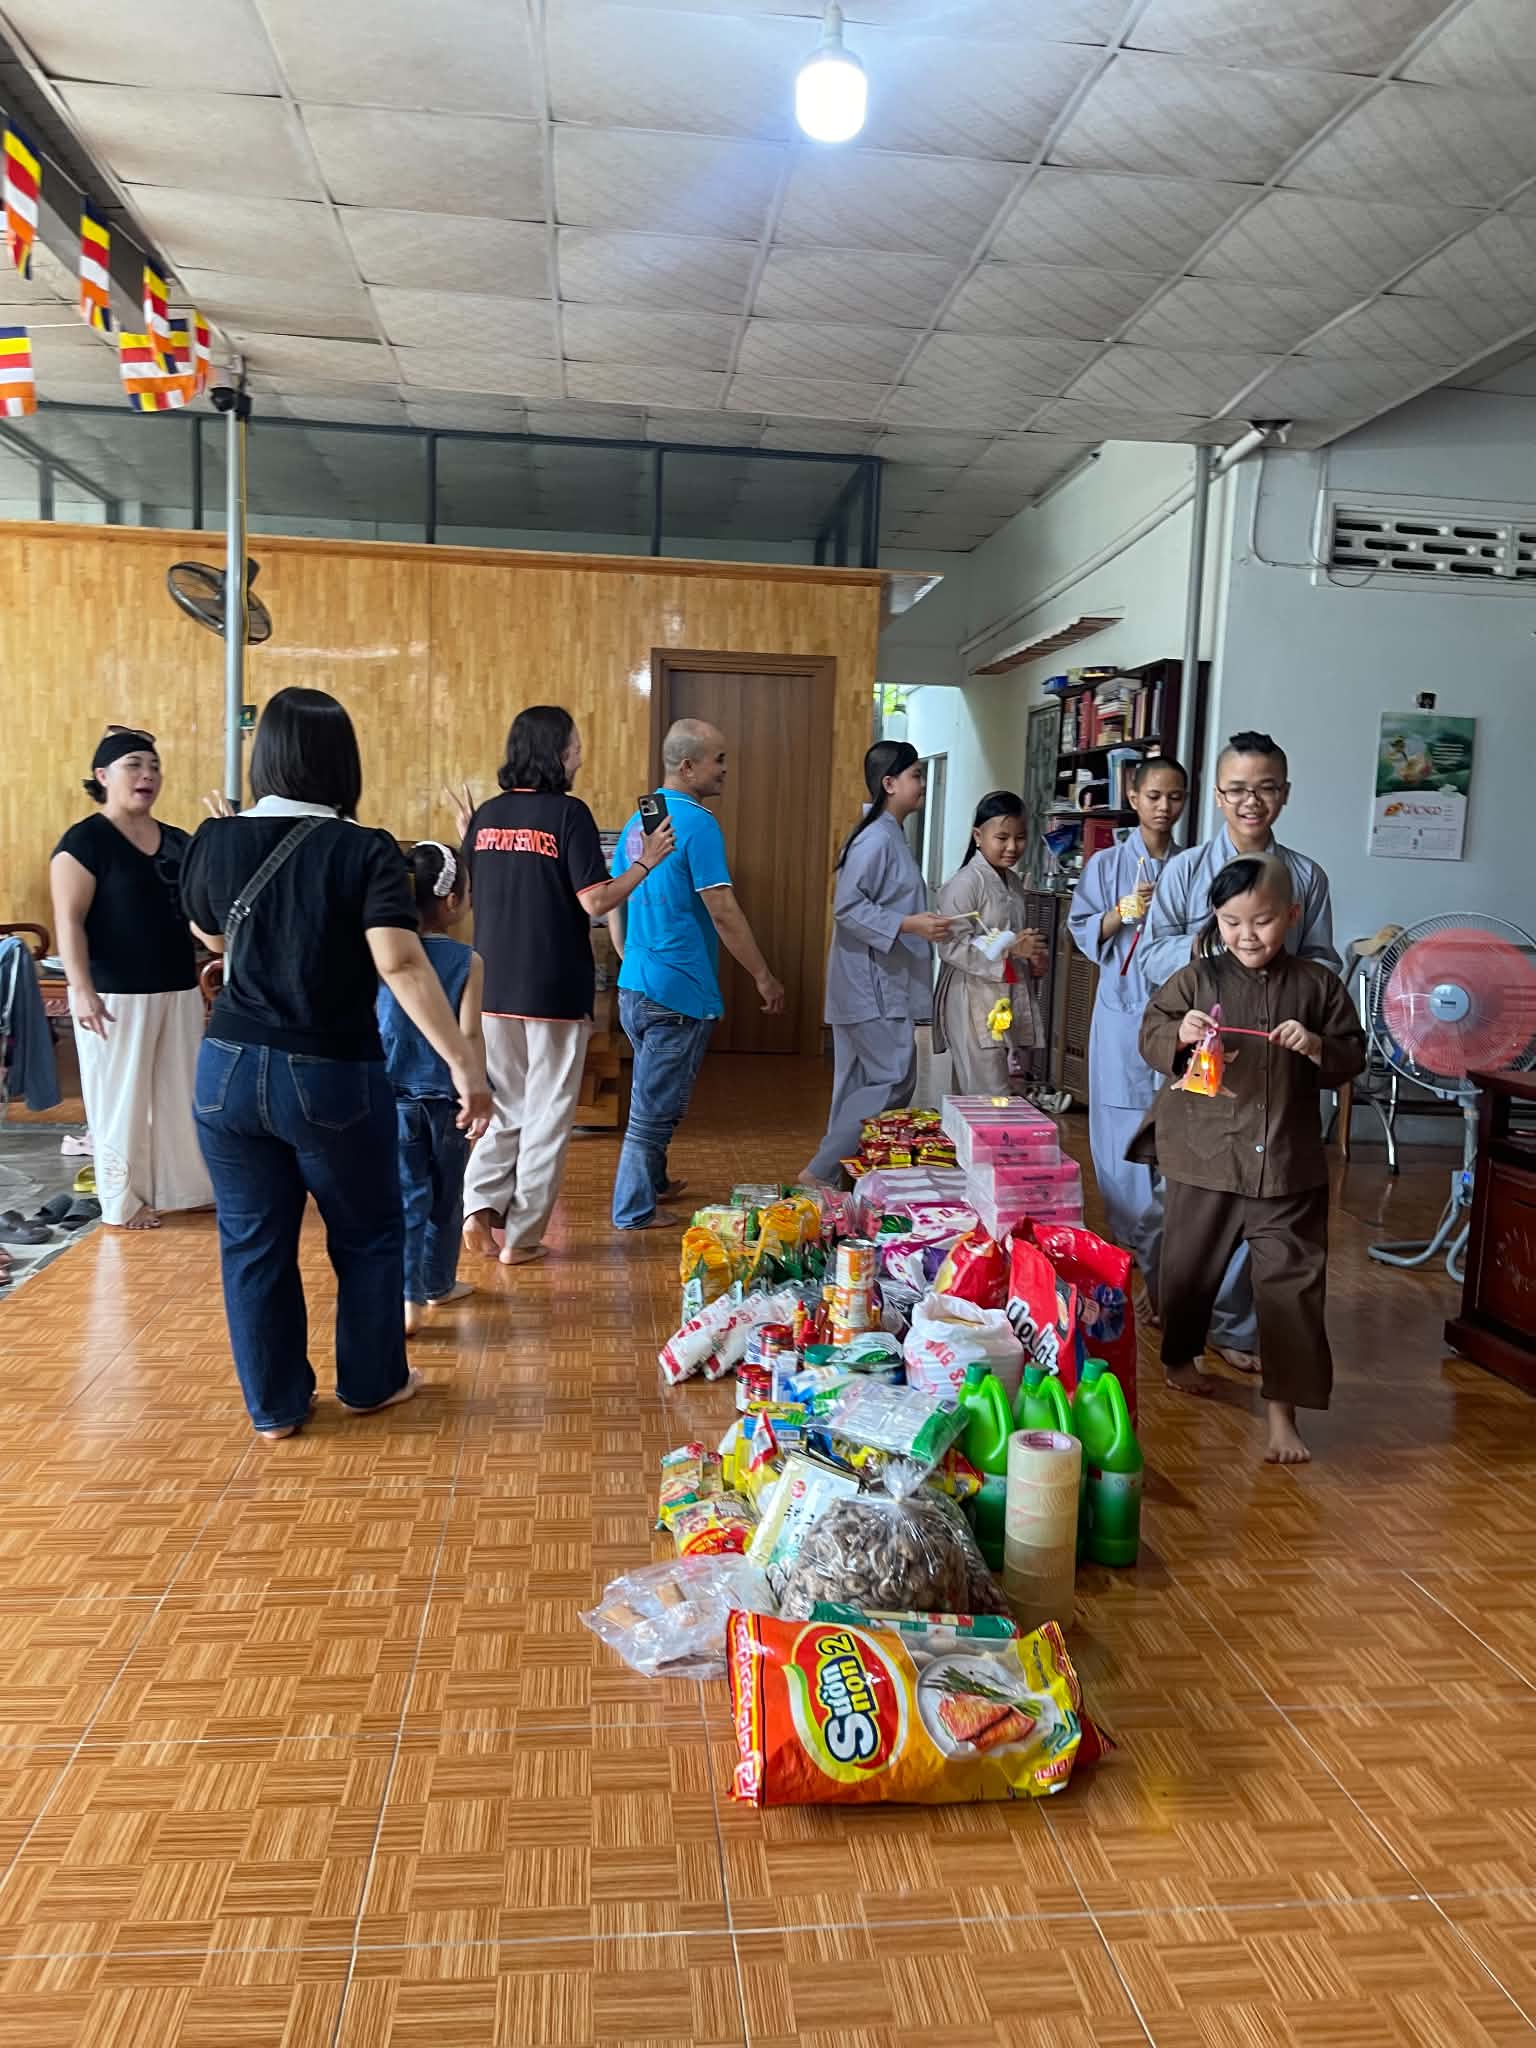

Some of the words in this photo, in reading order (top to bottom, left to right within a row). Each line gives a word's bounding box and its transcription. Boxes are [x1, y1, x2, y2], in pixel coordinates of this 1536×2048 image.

[818, 1633, 855, 1656] 2
[820, 1662, 876, 1760] Sườn
[839, 1659, 872, 1713] non
